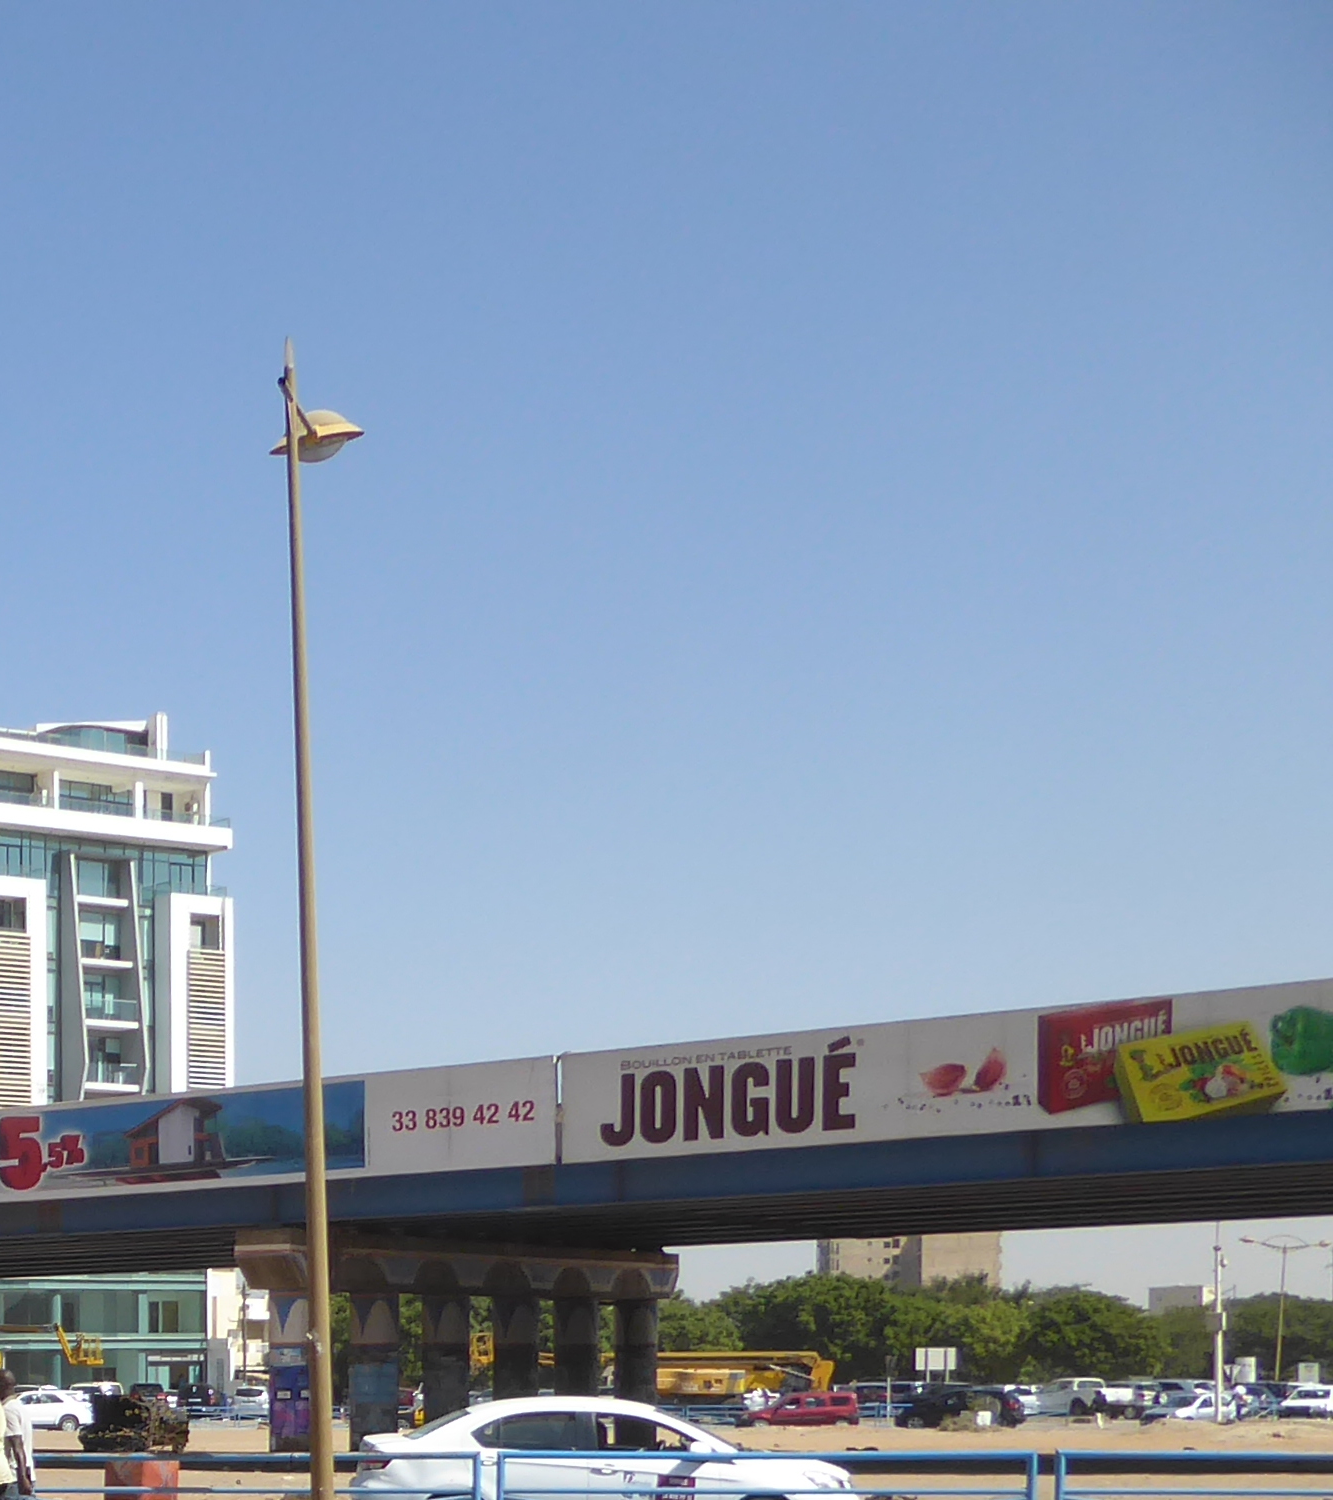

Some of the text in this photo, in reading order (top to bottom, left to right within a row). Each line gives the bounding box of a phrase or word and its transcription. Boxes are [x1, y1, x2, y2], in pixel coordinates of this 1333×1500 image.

[1087, 1010, 1168, 1052] JONGUÉ
[1166, 1028, 1259, 1069] JONGUÉ
[620, 1046, 793, 1071] BOUILLON EN TABLETTE
[600, 1035, 857, 1147] JONGUÉ
[392, 1100, 535, 1132] 33 839 42 42
